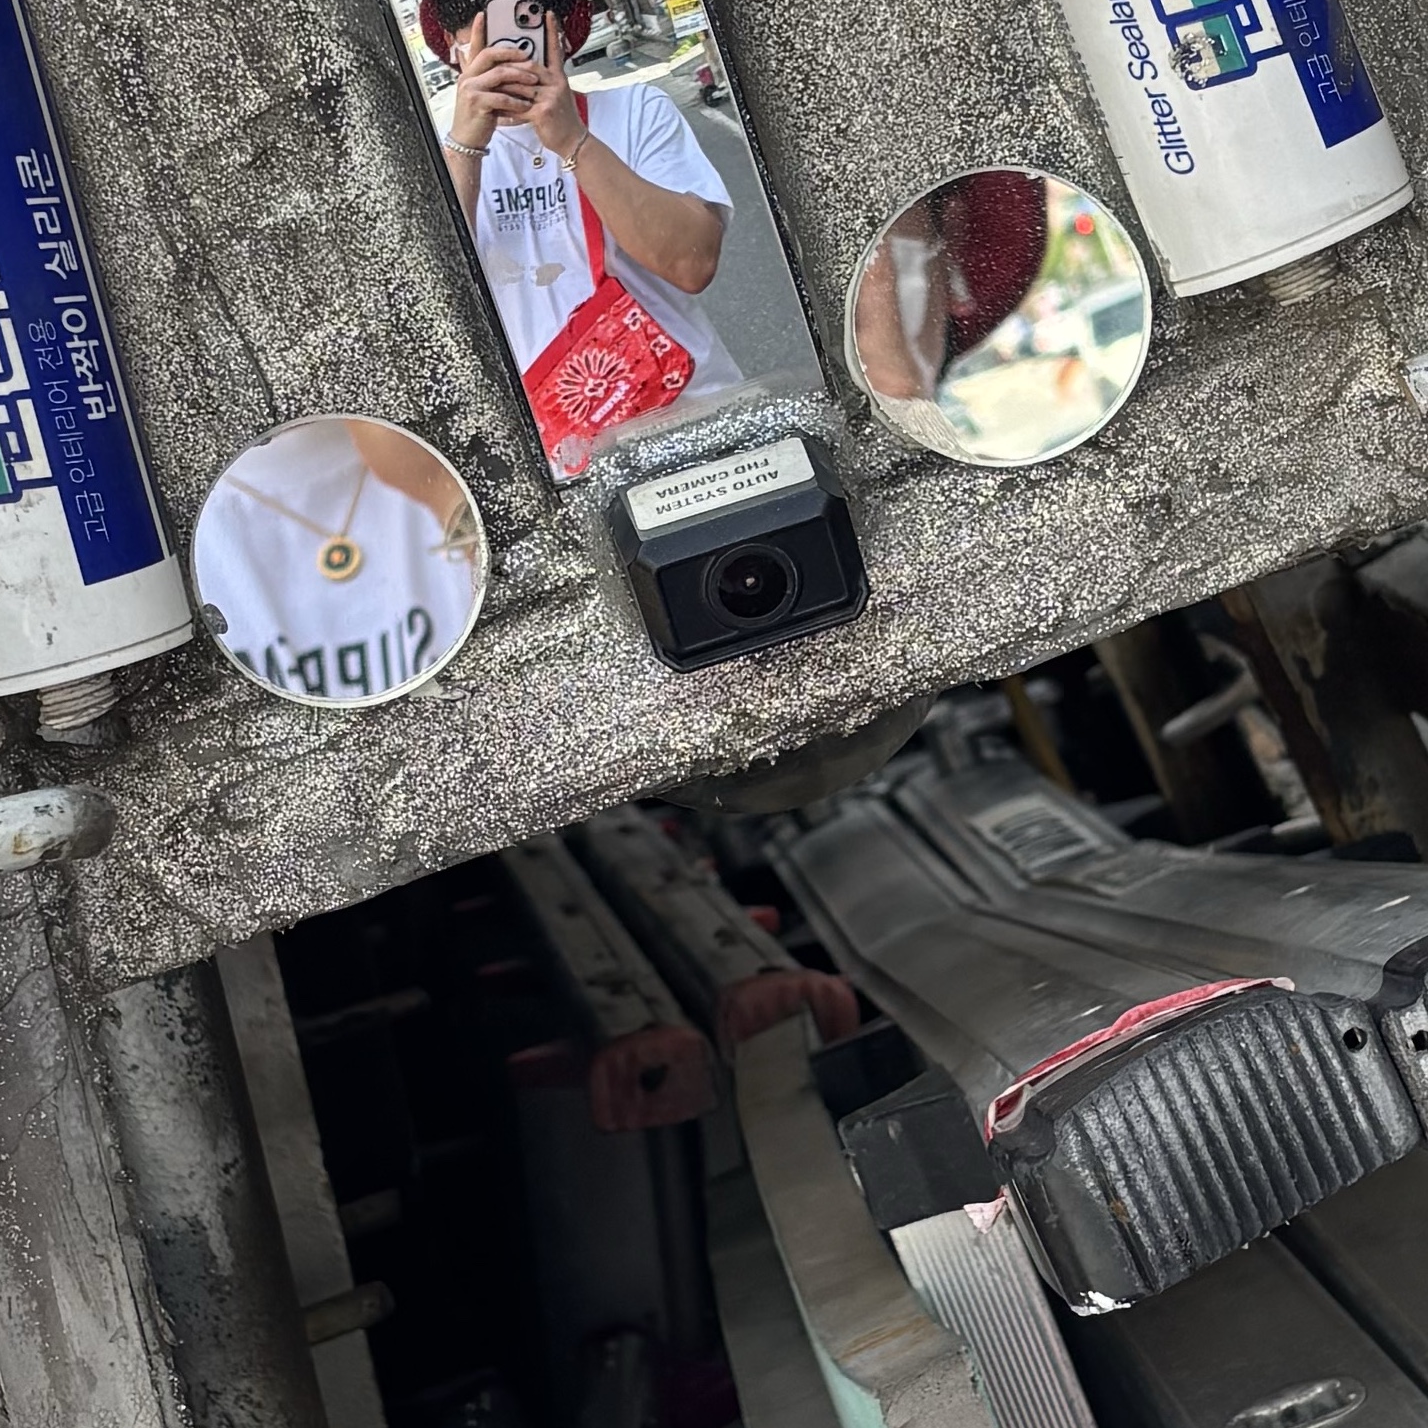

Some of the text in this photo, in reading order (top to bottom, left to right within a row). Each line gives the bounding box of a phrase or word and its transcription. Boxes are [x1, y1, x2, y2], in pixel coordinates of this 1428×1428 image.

[1305, 50, 1344, 108] 고급
[1138, 80, 1196, 179] Glitter
[11, 143, 121, 422] 반짝이 실리콘
[25, 314, 114, 546] 고급 인테리어 전용
[655, 457, 769, 499] FHD CAMERA
[655, 469, 779, 514] AUTO SYSTEM
